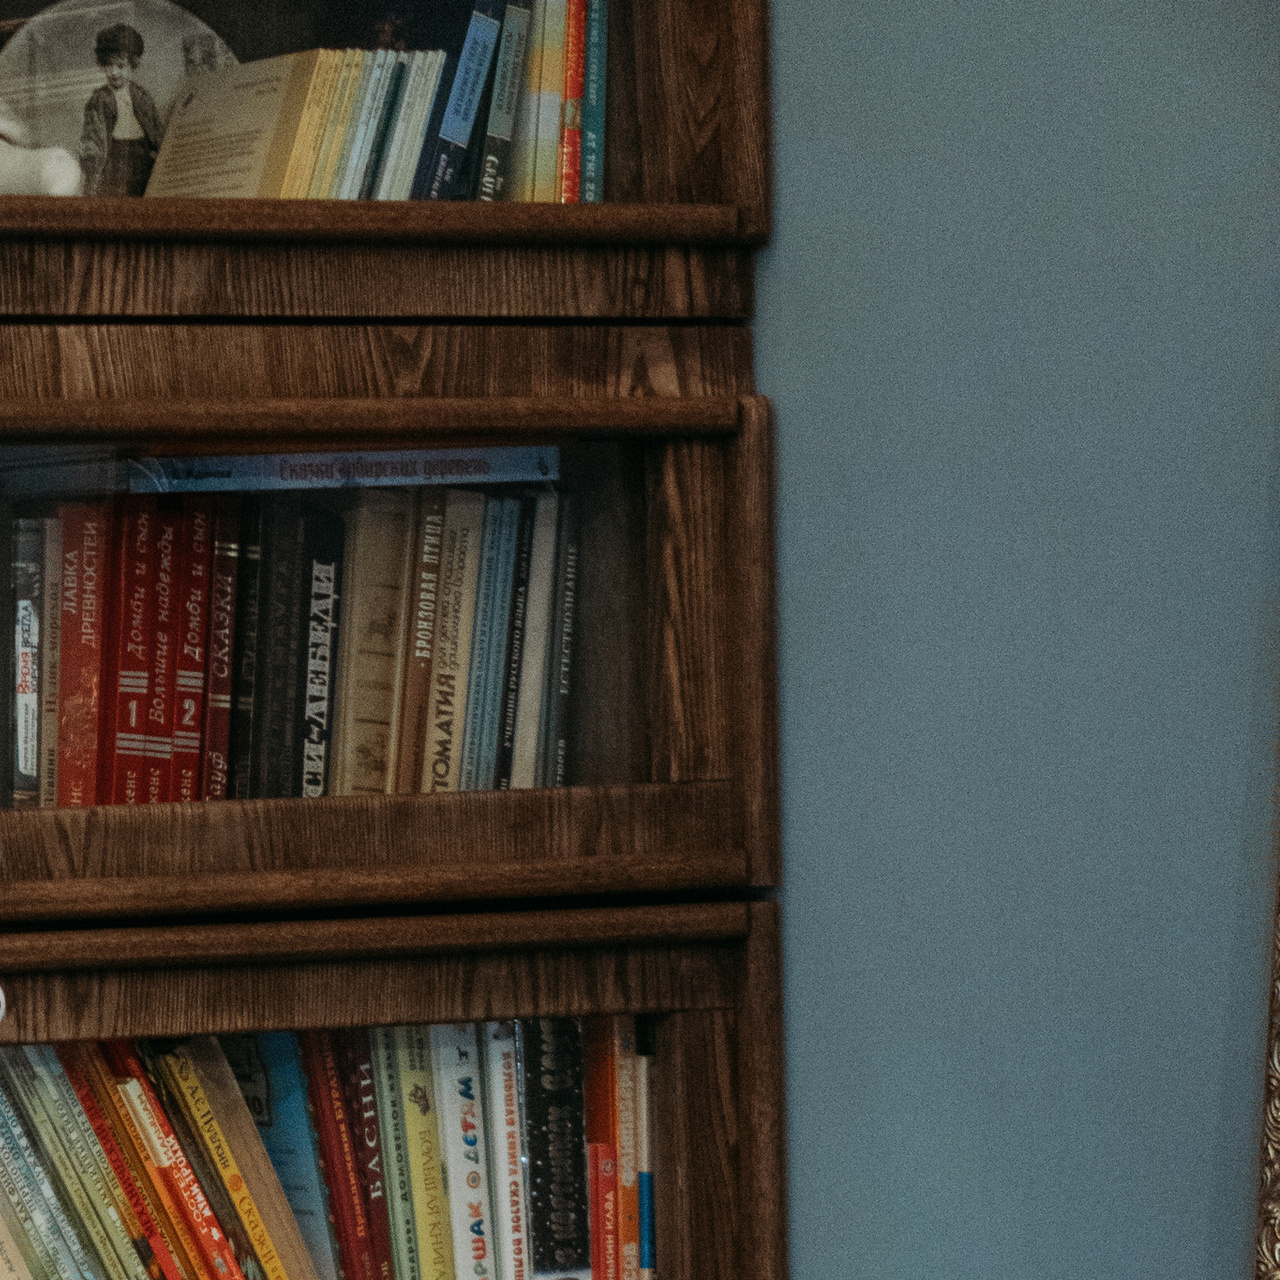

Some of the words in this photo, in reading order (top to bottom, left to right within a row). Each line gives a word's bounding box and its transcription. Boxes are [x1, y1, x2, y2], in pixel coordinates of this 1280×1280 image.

[134, 511, 149, 552] сын
[135, 561, 146, 574] и
[421, 513, 442, 563] ПТИЦА
[61, 548, 80, 613] ЛАВКА
[76, 520, 102, 647] ДРЕВНОСТЕЙ
[154, 525, 173, 621] надежды
[191, 563, 203, 575] и
[126, 586, 147, 659] Домби
[183, 588, 202, 661] Домби
[212, 574, 231, 677] СКАЗКИ
[413, 571, 438, 658] БРОНЗОВАЯ
[514, 585, 527, 627] ЯЗЫКА
[553, 543, 583, 694] ЕСТЕСТВОЗНАНИЕ
[148, 631, 168, 723] Большие
[302, 558, 338, 797] СИ-ЛЕБЕДИ
[508, 629, 523, 689] РУССКОГО
[503, 691, 518, 747] УЧЕБНИК
[455, 1075, 481, 1165] ДЕТЯМ
[500, 1050, 518, 1127] БОЛЬШАЯ
[195, 1110, 236, 1170] Пушкин
[351, 1061, 390, 1199] БАСНИ
[505, 1130, 520, 1176] КНИГА
[338, 1122, 366, 1237] Приключения
[417, 1128, 440, 1216] БОЛЬШАЯ
[507, 1180, 522, 1235] СКАЗОК
[10, 1197, 30, 1224] КАК
[604, 1191, 615, 1229] клад
